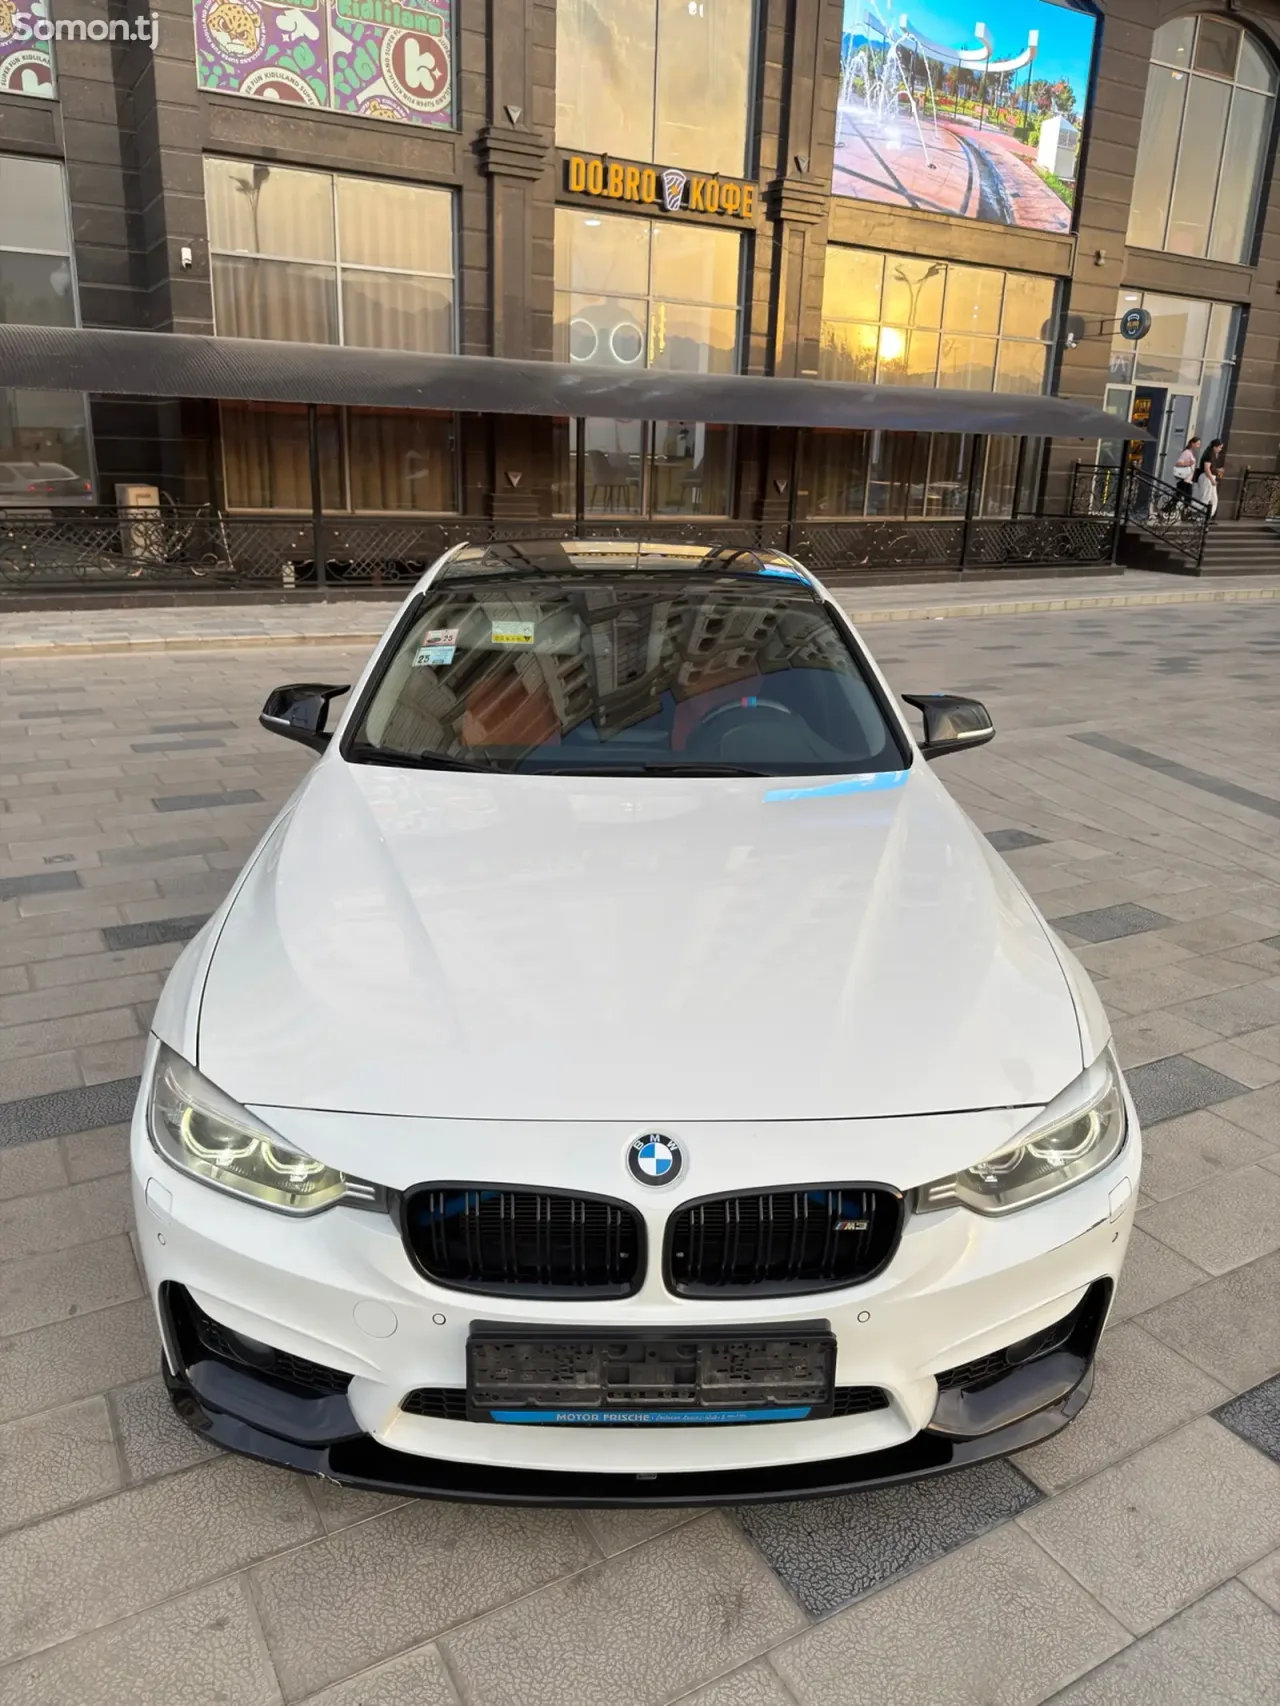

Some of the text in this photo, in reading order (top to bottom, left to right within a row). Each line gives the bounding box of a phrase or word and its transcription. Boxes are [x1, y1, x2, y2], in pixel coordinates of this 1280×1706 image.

[8, 57, 21, 69] FUN
[250, 76, 263, 90] FUN
[264, 71, 300, 88] KIDLILAND
[569, 157, 656, 203] DO.BRO
[688, 176, 755, 218] КОФЕ
[417, 655, 430, 664] 25
[633, 1134, 678, 1151] BMW
[556, 1413, 600, 1421] MOTOR
